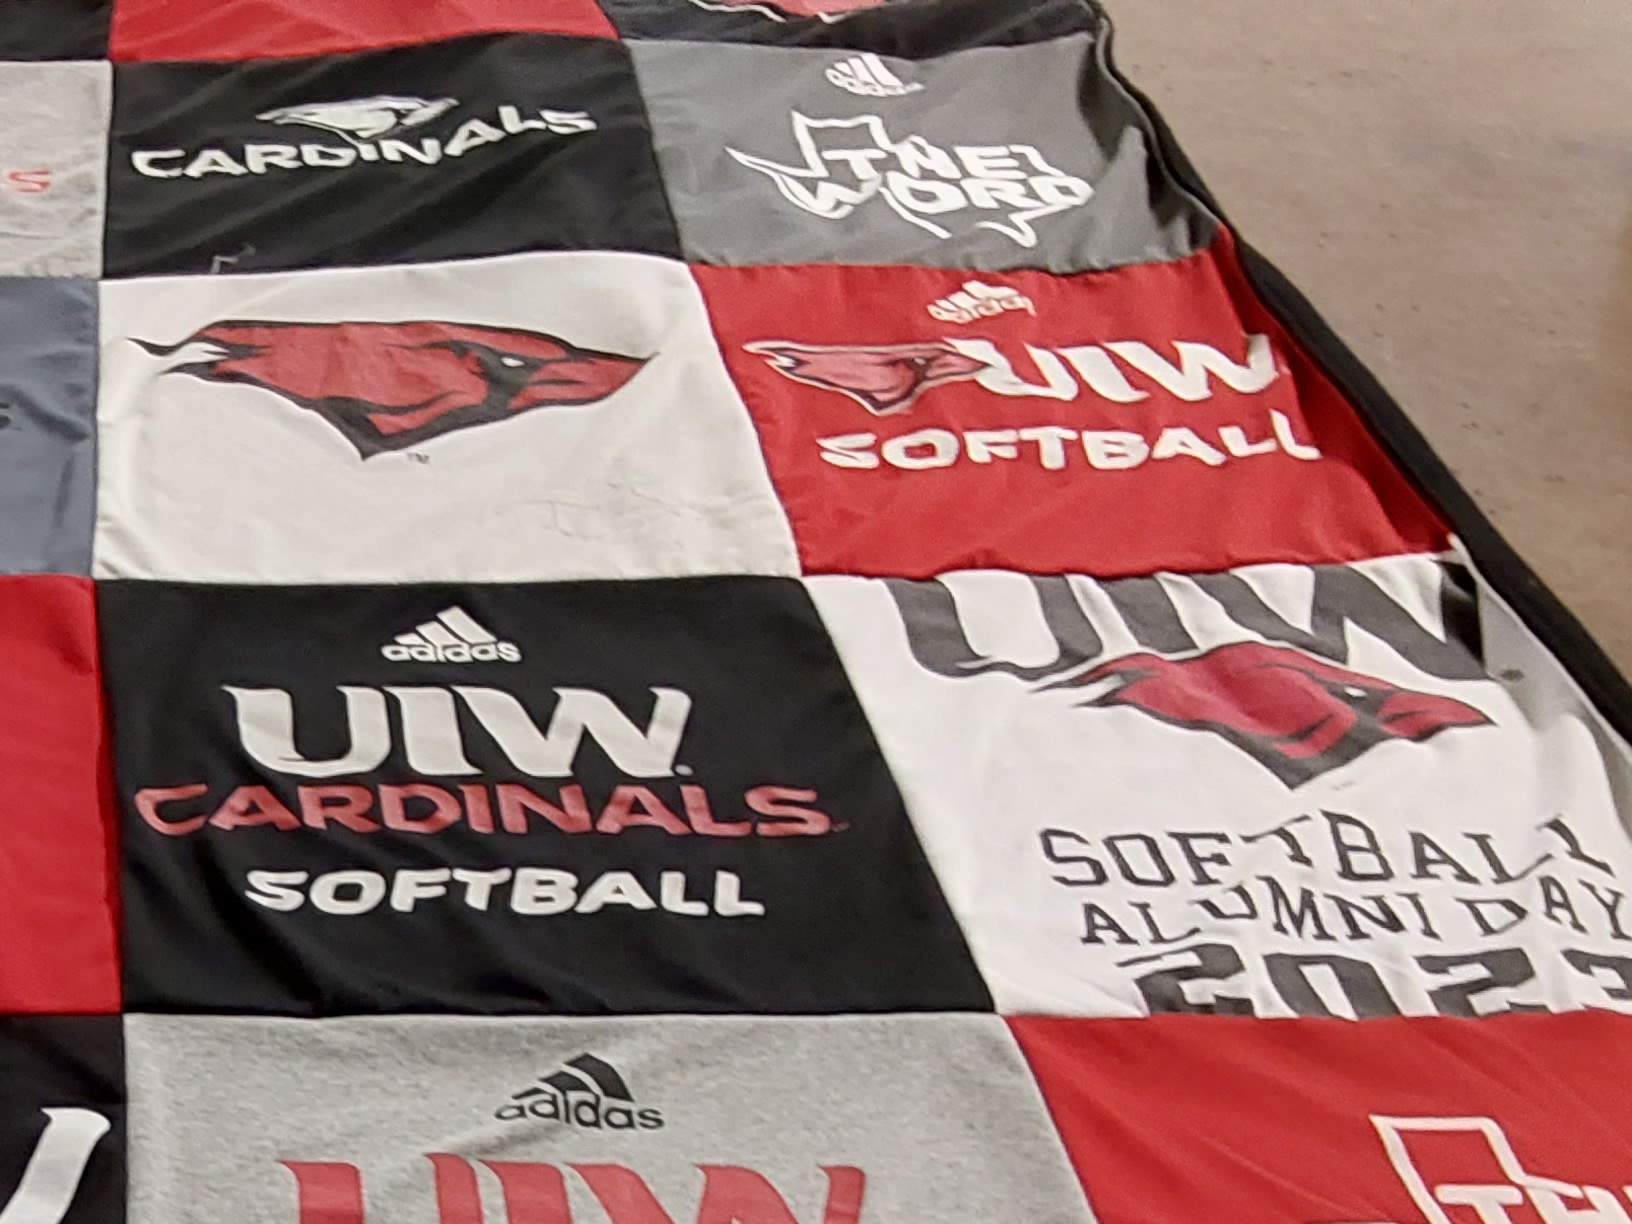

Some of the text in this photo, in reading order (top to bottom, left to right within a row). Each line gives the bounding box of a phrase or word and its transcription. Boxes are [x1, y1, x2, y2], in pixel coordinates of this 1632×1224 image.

[131, 105, 598, 179] CARDINALS
[822, 138, 1027, 181] THE
[779, 172, 1094, 214] WORD
[944, 333, 1279, 401] UIW
[817, 408, 1322, 470] SOFTBALL
[382, 640, 522, 664] adidas
[881, 561, 1496, 682] UIW
[220, 685, 694, 779] UIW
[134, 784, 834, 837] CARDINALS
[1038, 808, 1616, 886] SOFTBALL
[244, 866, 767, 917] SOFTBALL
[1080, 875, 1632, 944] ALUMNI DAY
[495, 1089, 665, 1130] adidas
